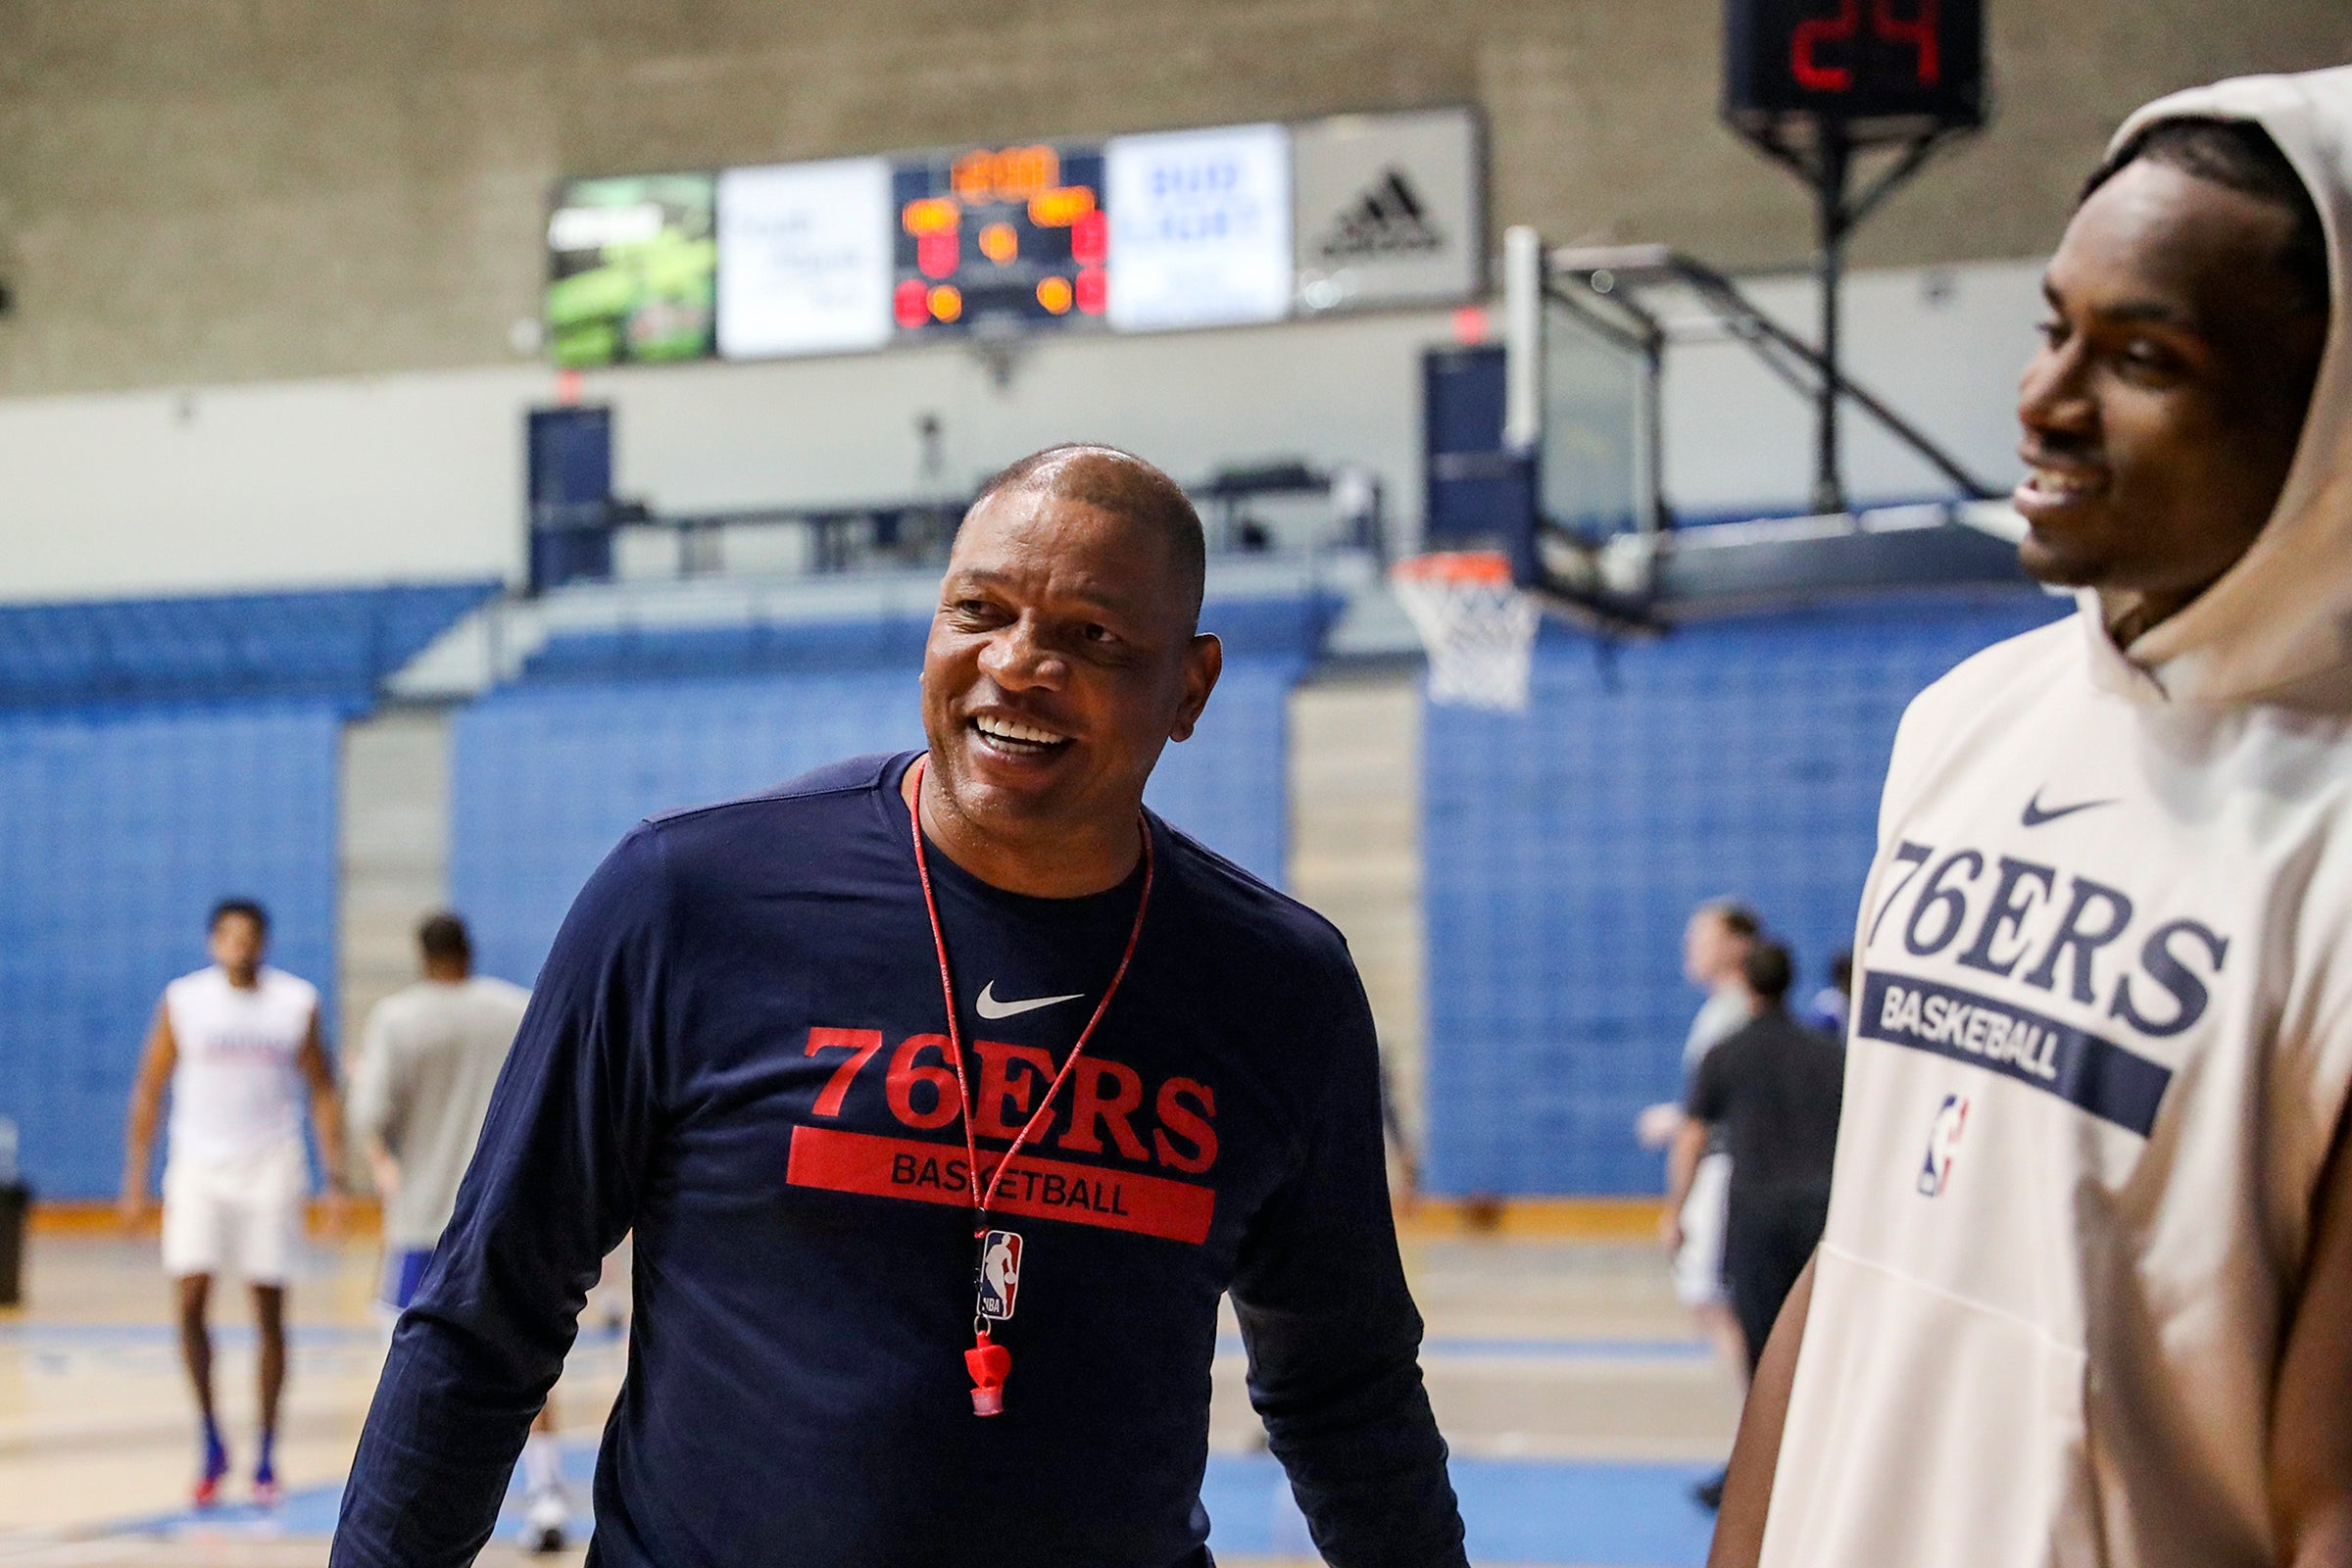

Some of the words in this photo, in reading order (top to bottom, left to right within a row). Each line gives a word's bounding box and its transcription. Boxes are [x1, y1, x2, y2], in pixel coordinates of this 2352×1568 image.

[1791, 0, 1941, 90] 24
[1868, 838, 2230, 1039] 76ERS
[804, 1026, 1219, 1175] 76ERS
